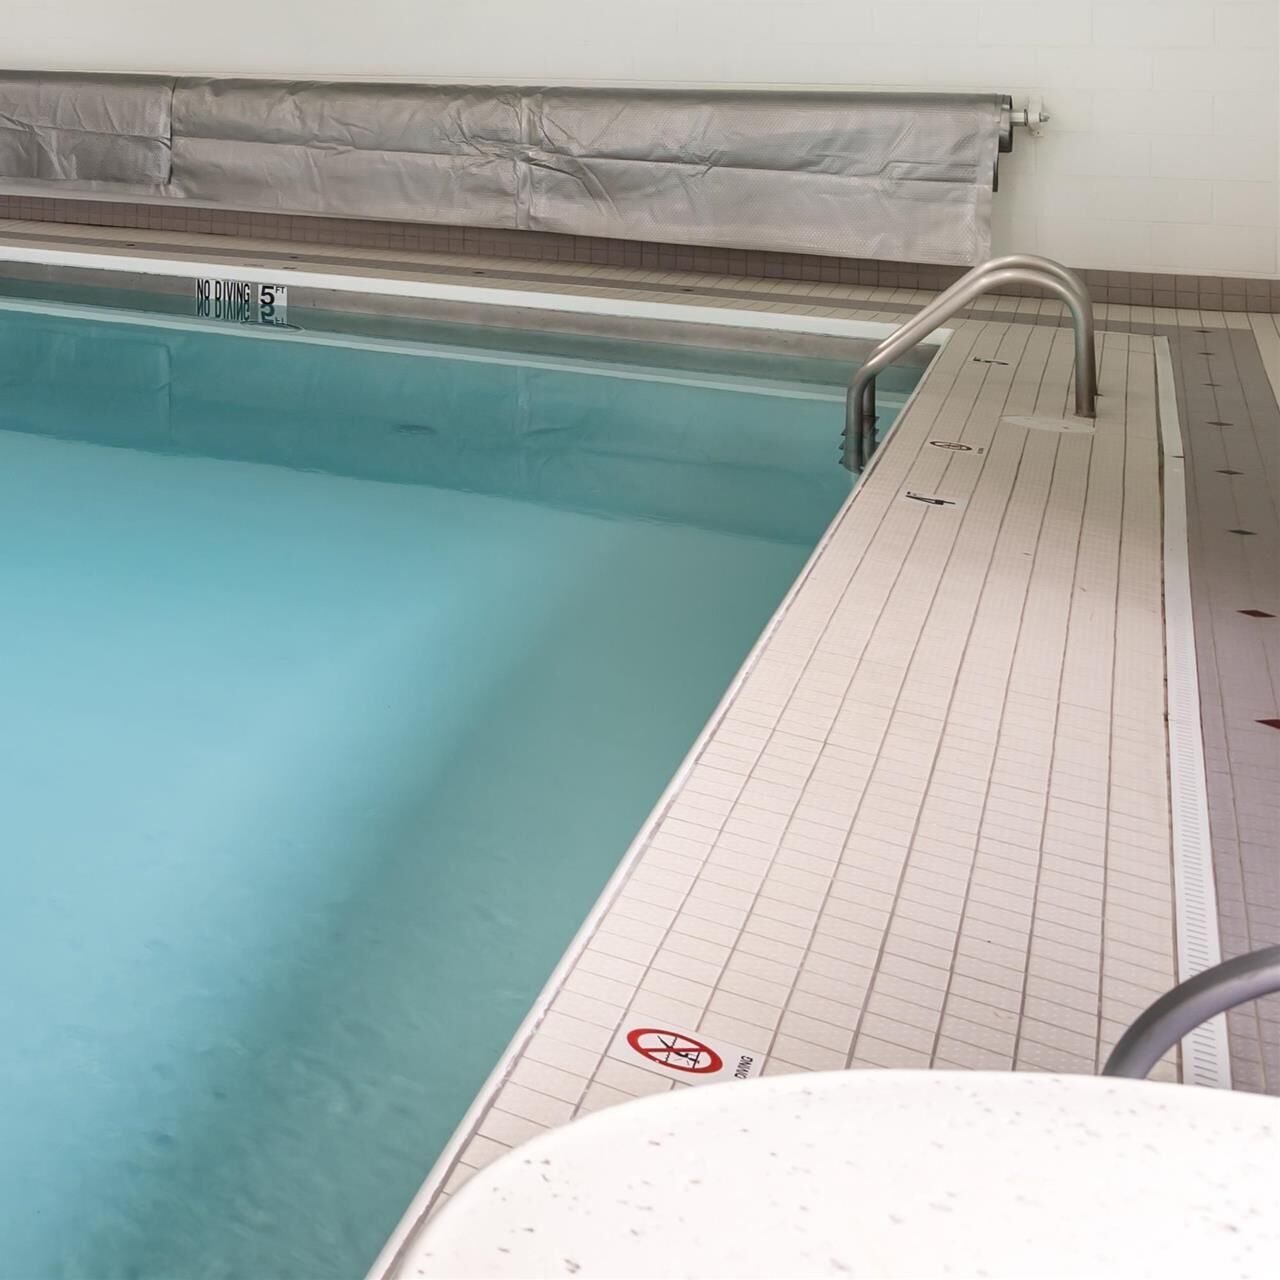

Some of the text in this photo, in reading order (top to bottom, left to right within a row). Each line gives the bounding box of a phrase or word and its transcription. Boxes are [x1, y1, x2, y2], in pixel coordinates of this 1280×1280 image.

[197, 279, 250, 304] NO DIVING
[260, 285, 286, 305] 5 FT
[734, 1055, 753, 1079] DIVING
